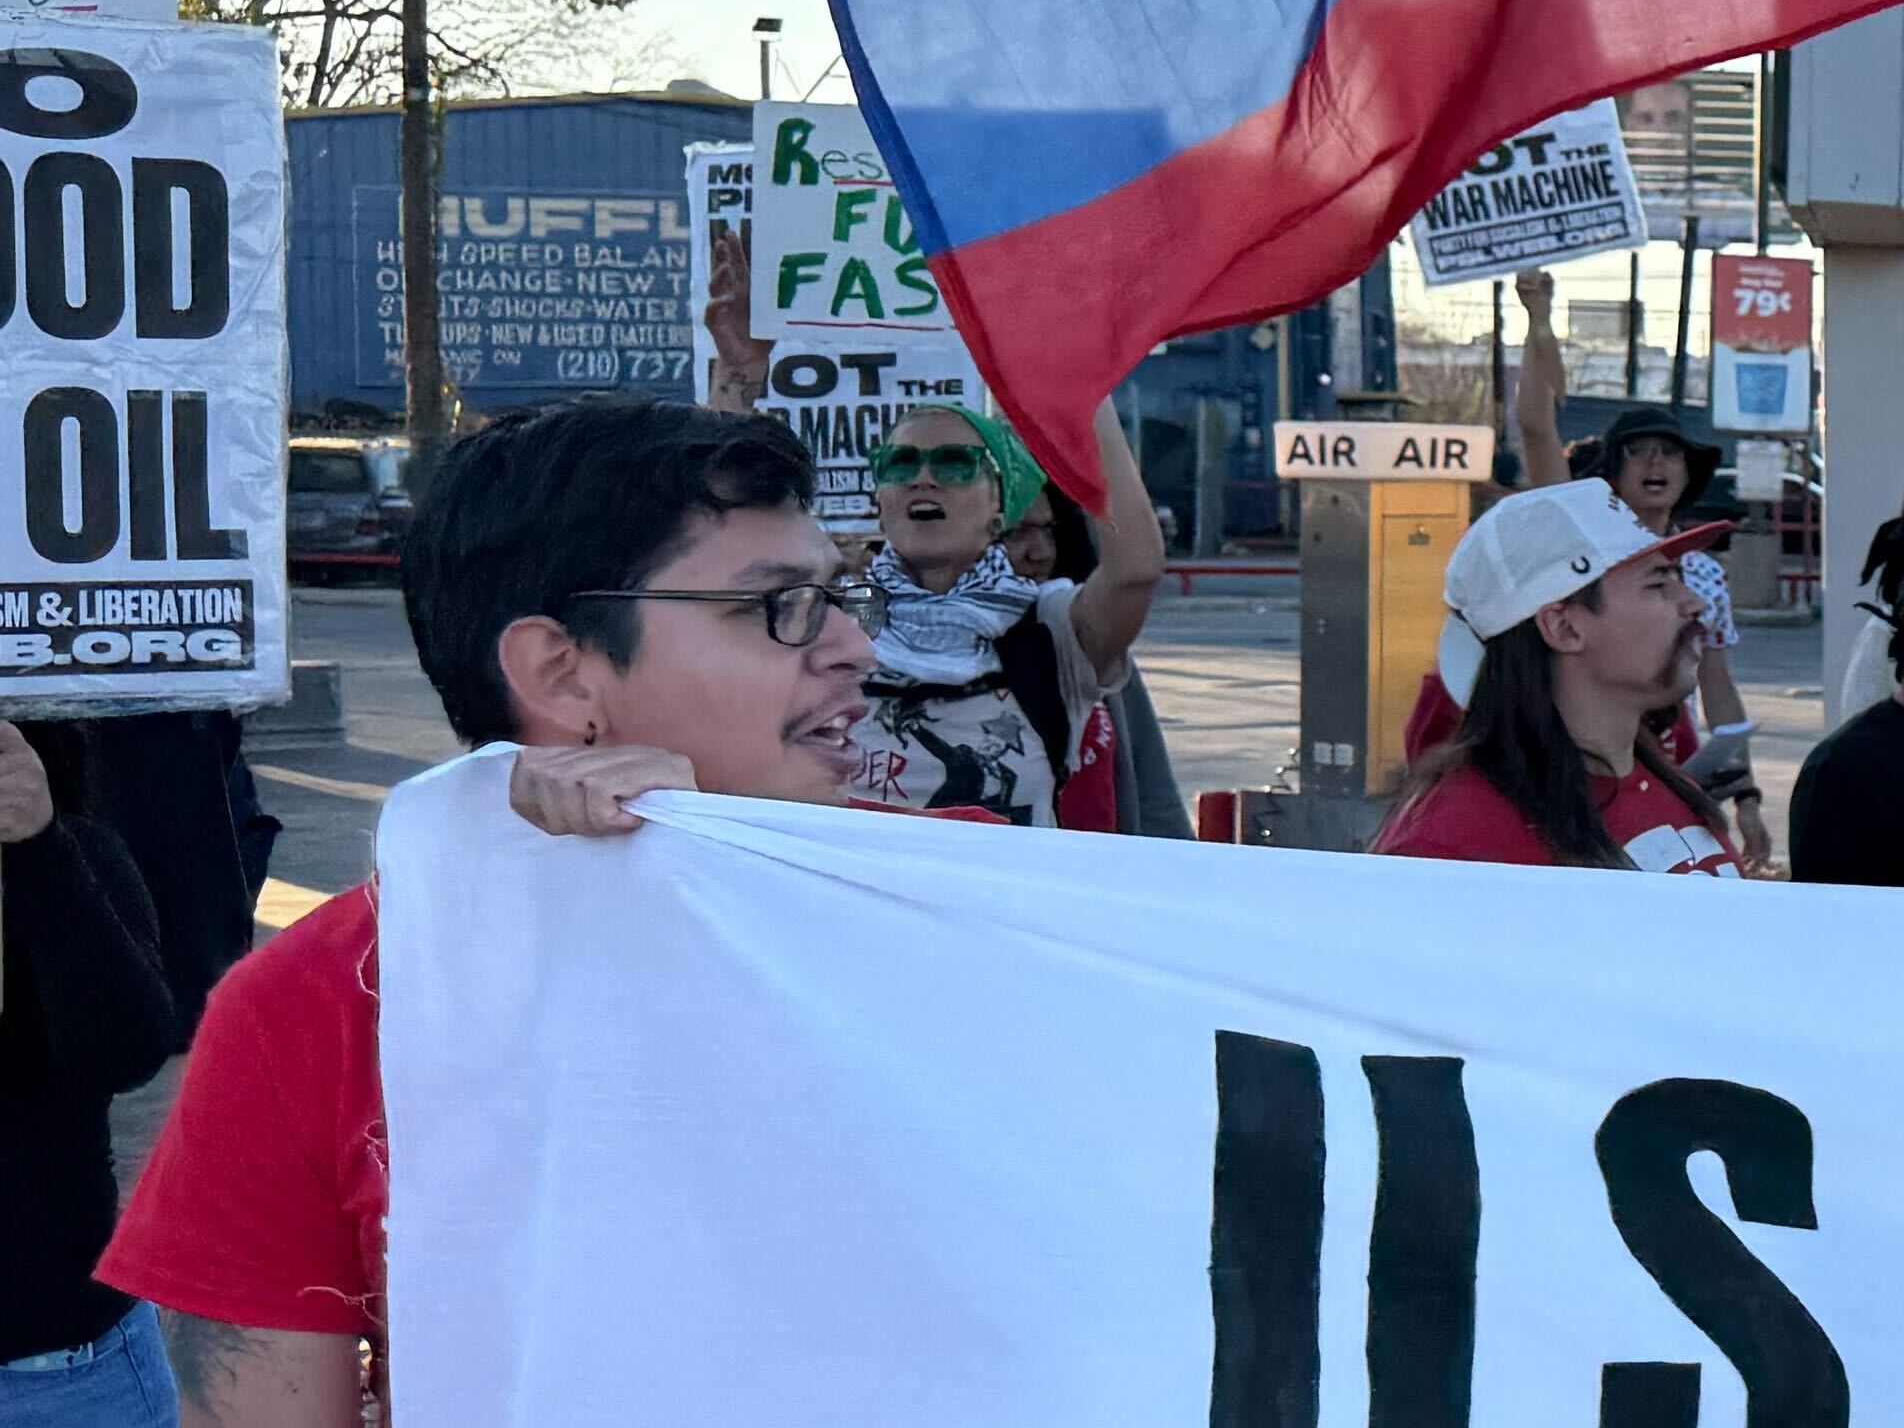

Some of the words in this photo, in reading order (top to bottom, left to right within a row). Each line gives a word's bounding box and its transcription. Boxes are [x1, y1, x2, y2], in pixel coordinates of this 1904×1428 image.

[1462, 132, 1557, 178] OT
[1422, 183, 1491, 231] WAR
[1490, 160, 1622, 217] MACHINE
[0, 152, 230, 340] OD
[460, 241, 564, 268] SPEED
[593, 298, 679, 322] WATER
[556, 350, 620, 382] (210)
[625, 350, 691, 380] 737
[897, 378, 963, 396] THE
[1287, 434, 1358, 468] AIR
[1393, 437, 1470, 470] AIR
[24, 387, 249, 565] OIL
[36, 592, 73, 627] &
[79, 587, 243, 626] LIBERATION
